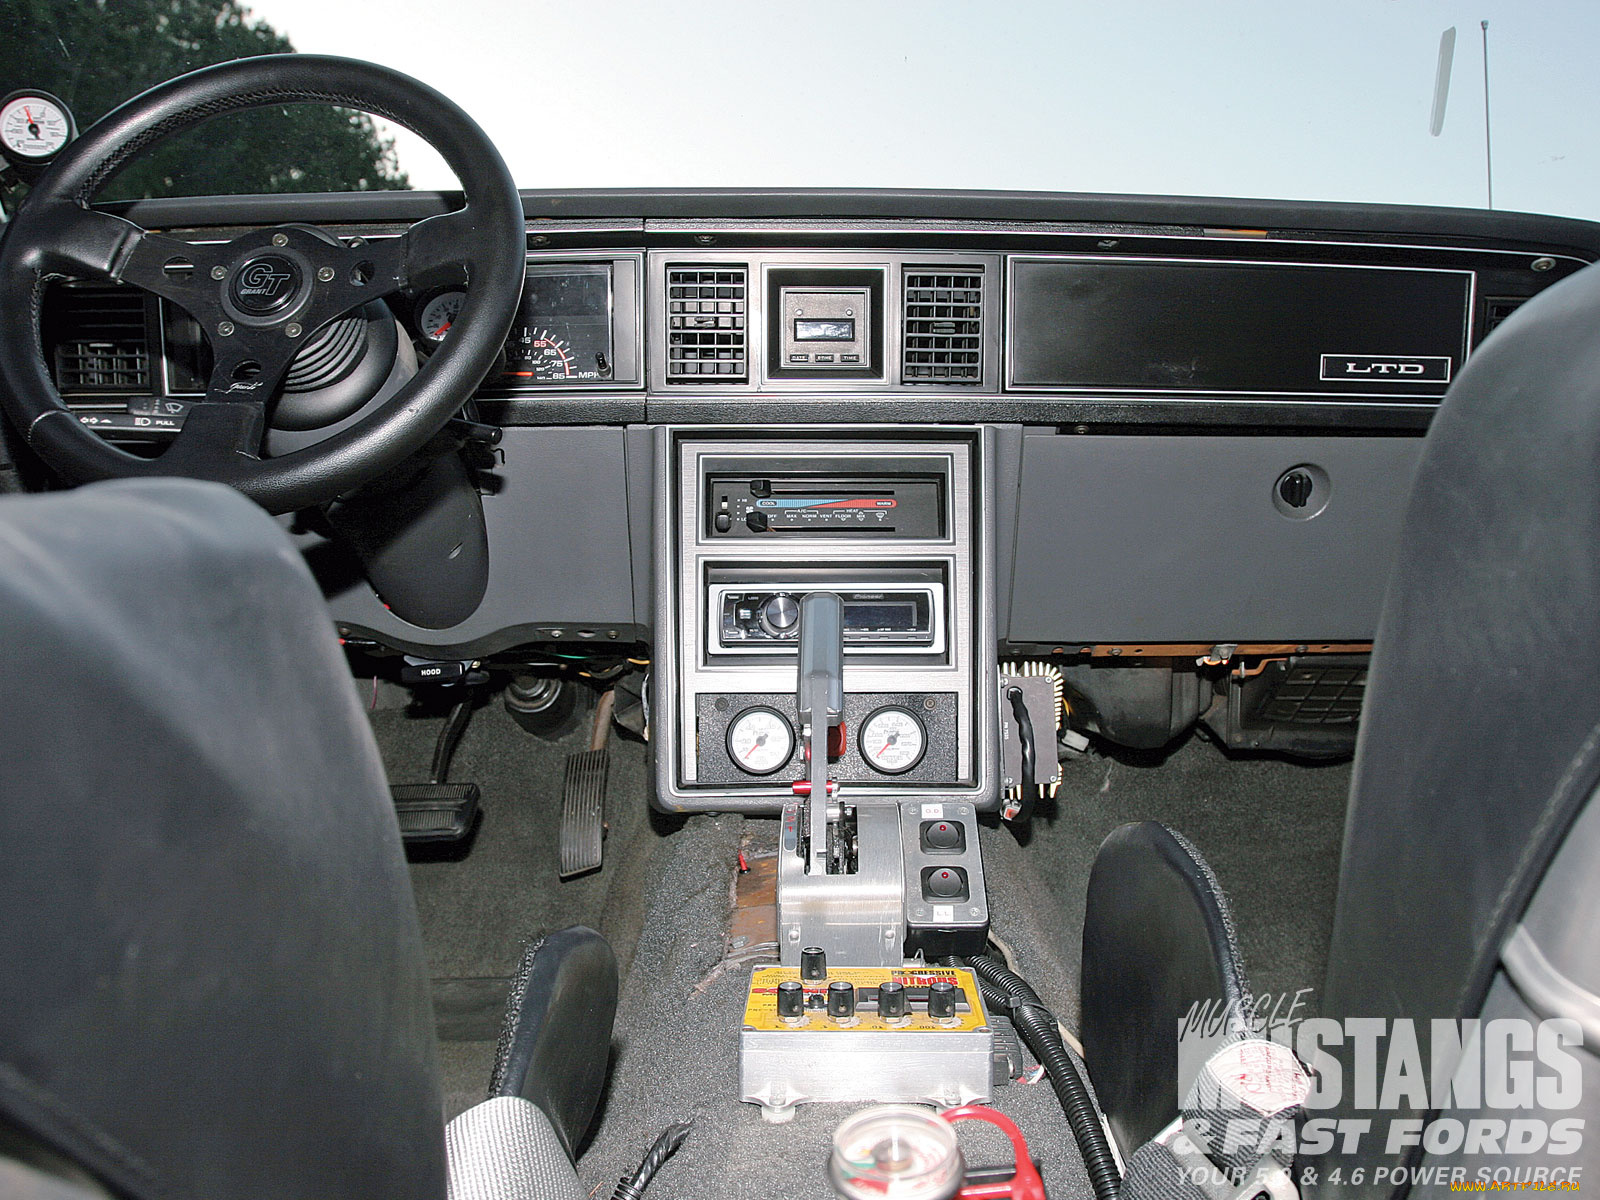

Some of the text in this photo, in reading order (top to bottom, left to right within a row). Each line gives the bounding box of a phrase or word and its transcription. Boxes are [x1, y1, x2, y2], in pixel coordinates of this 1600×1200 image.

[242, 264, 290, 295] GT
[1345, 362, 1425, 375] LTD
[421, 668, 441, 676] HOOD
[892, 976, 959, 985] NITROUS
